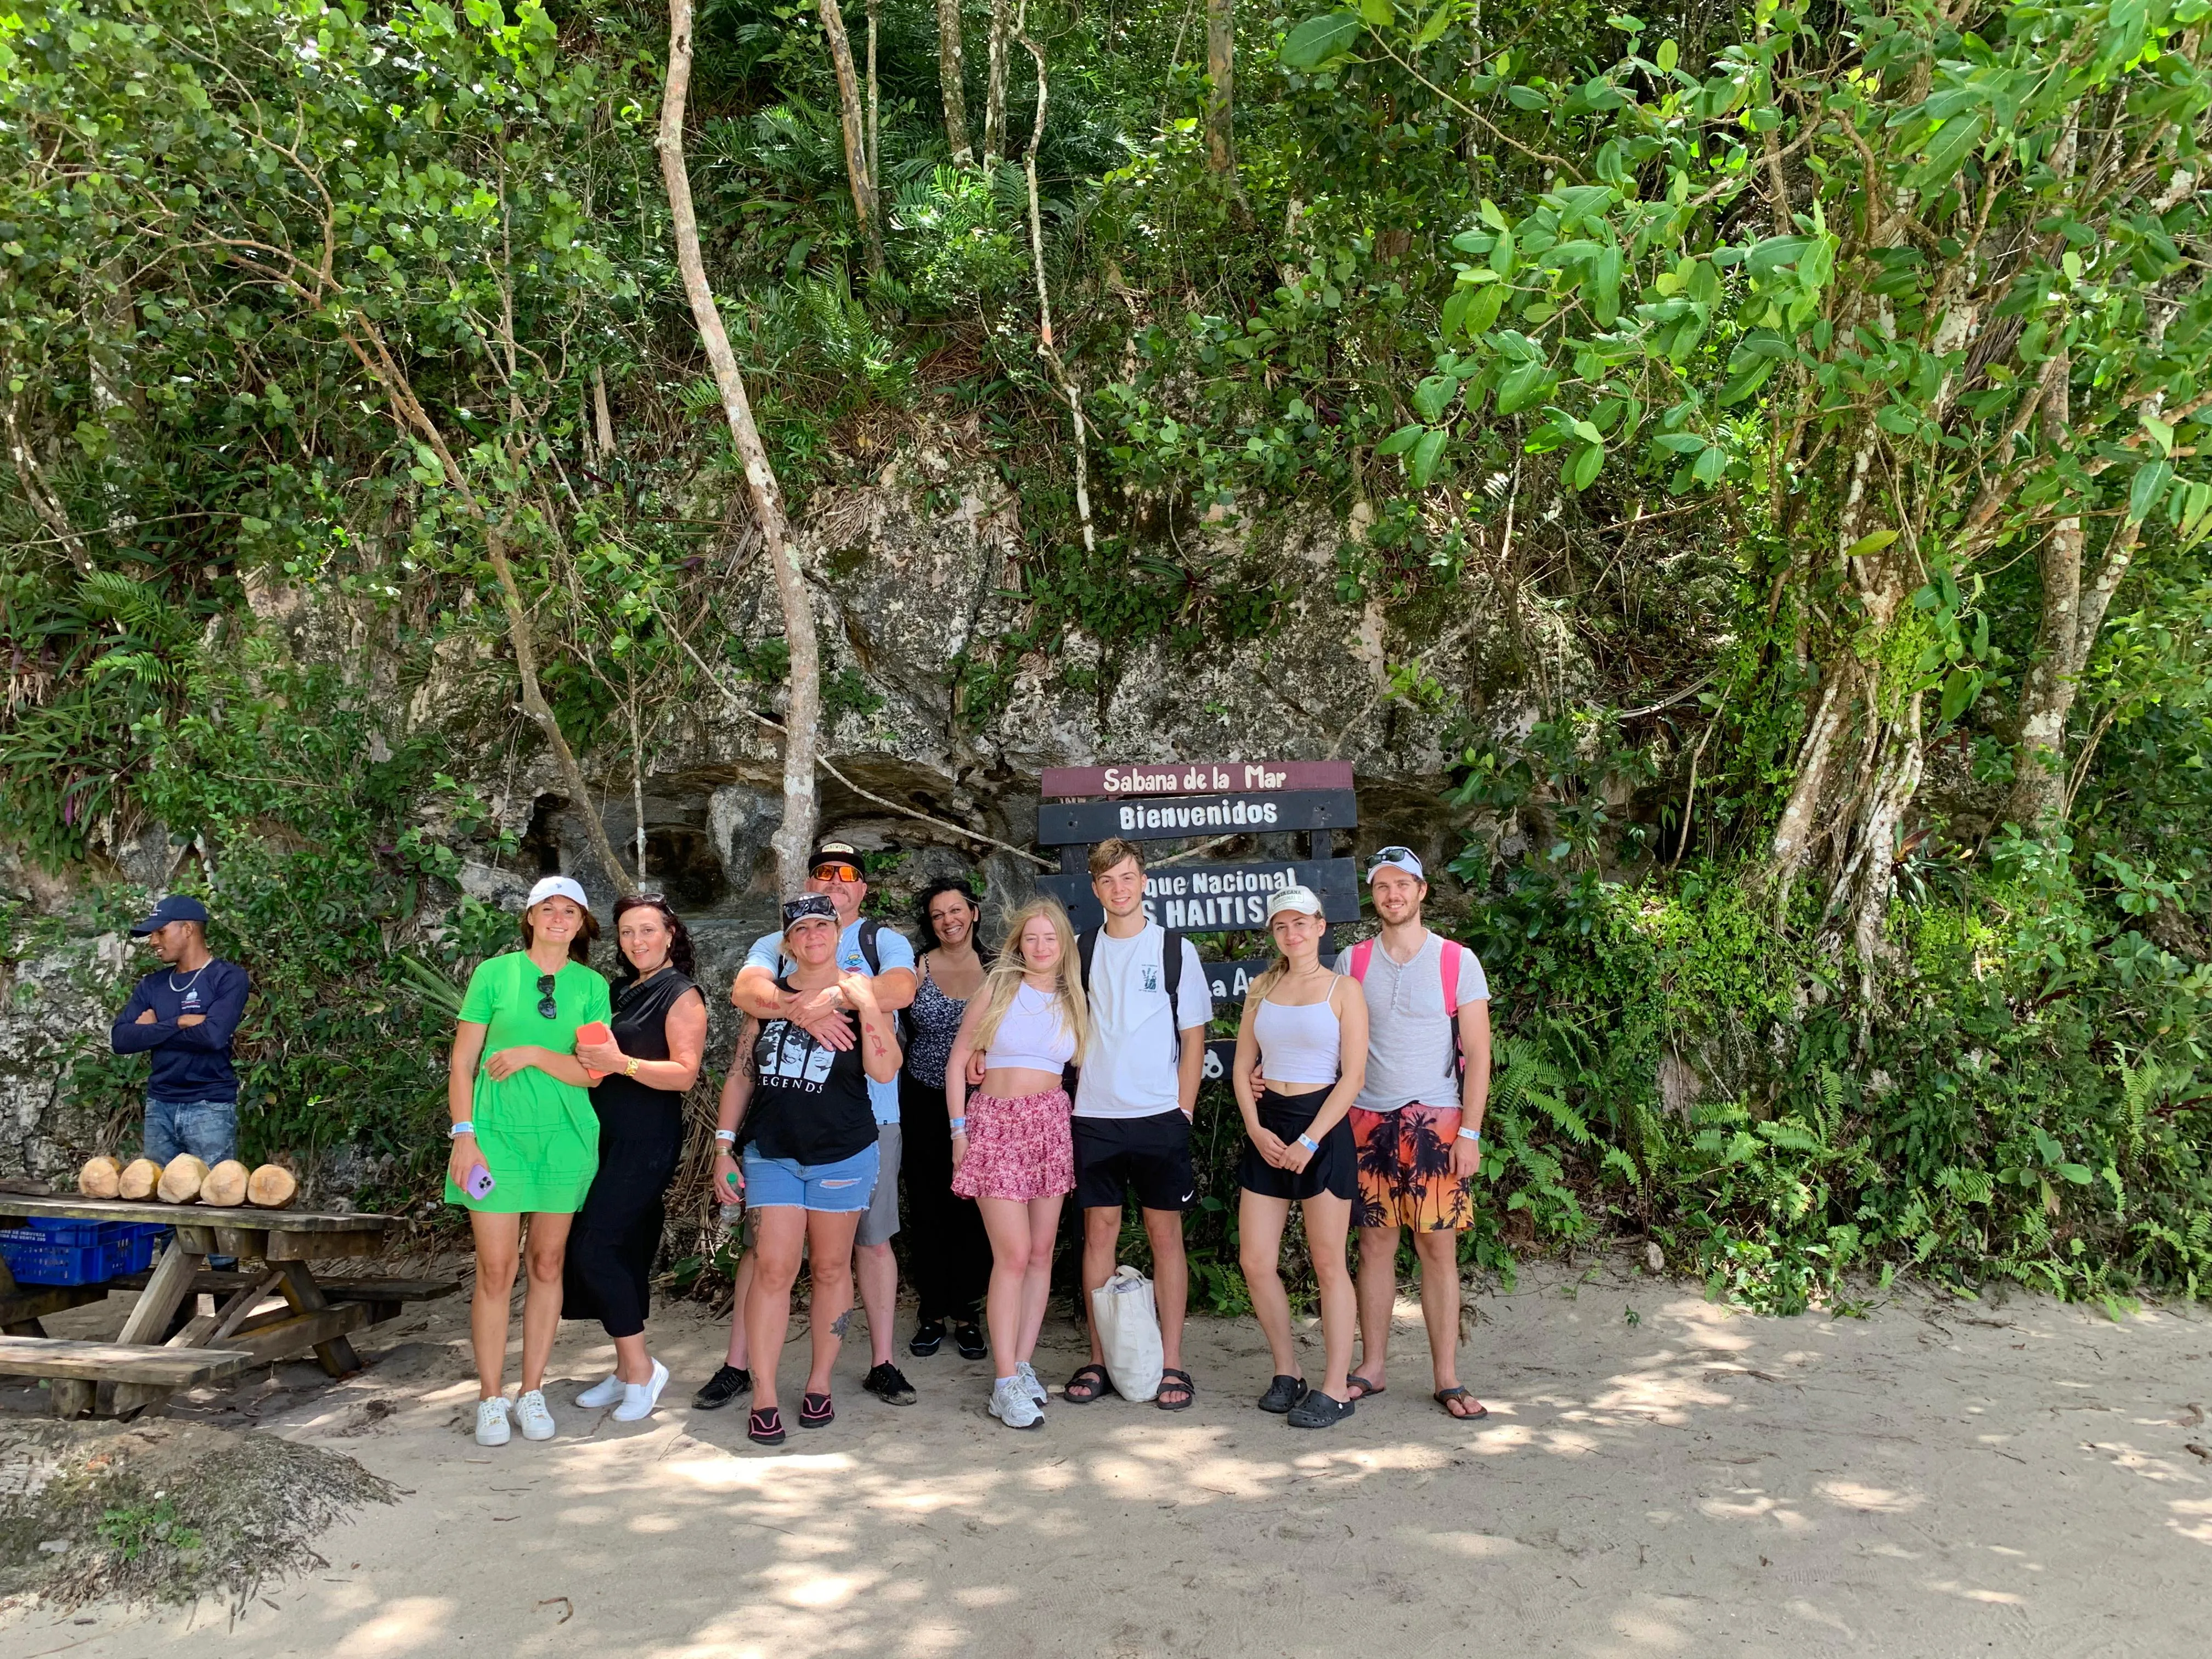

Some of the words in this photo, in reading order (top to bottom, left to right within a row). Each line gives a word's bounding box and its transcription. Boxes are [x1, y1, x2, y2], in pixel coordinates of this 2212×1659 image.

[1104, 768, 1177, 792] Sabana
[1183, 766, 1207, 791] de
[1213, 766, 1229, 789] la
[1245, 765, 1286, 788] Mar
[1120, 799, 1277, 830] Bienvenidos
[1144, 876, 1187, 898] que
[1193, 867, 1297, 894] Nacional
[1166, 895, 1273, 929] HAITIS
